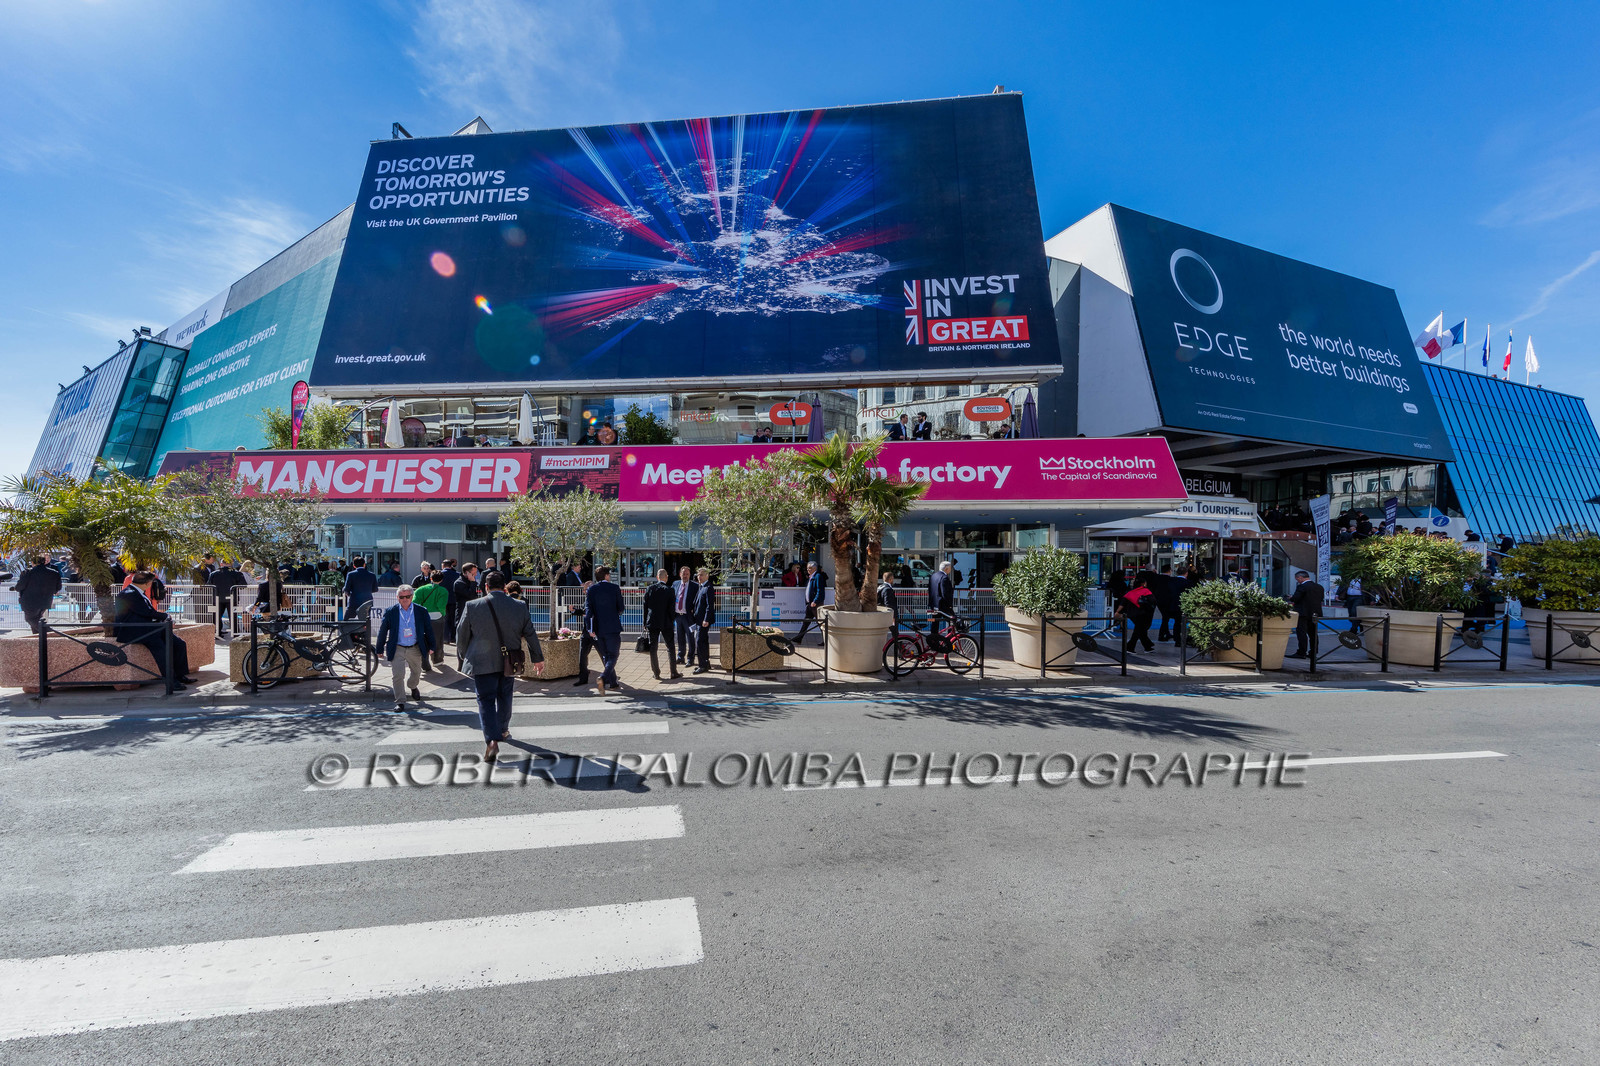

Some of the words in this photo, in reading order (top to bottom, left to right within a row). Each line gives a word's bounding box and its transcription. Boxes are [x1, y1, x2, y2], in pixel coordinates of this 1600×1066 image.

[377, 154, 475, 175] DISCOVER
[374, 170, 506, 192] TOMORROW'S
[369, 186, 530, 211] OPPORTUNITIES
[366, 219, 388, 228] Visit
[389, 218, 404, 227] the
[406, 217, 421, 226] UK
[423, 215, 479, 226] Government
[481, 213, 518, 223] Pavilion
[924, 274, 1020, 298] INVEST
[925, 298, 951, 318] IN
[931, 318, 1024, 341] GREAT
[185, 355, 213, 378] GLOBALLY
[211, 341, 248, 366] CONNECTED
[247, 324, 278, 349] EXPERTS
[1000, 342, 1031, 350] IRELAND
[1173, 322, 1253, 361] EDGE
[1278, 323, 1308, 346] the
[1310, 333, 1355, 358] world
[1358, 345, 1402, 368] needs
[334, 351, 427, 365] invest.great.gov.uk
[179, 376, 205, 396] SHARING
[204, 371, 218, 385] ONE
[217, 355, 251, 378] OBJECTIVE
[1189, 366, 1256, 385] TECHNOLOGIES
[1286, 349, 1338, 377] better
[1340, 360, 1410, 394] buildings
[170, 400, 206, 423] EXCEPTIONAL
[205, 386, 240, 410] OUTCOMES
[239, 381, 255, 398] FOR
[254, 371, 279, 390] EVERY
[279, 358, 310, 381] CLIENT
[545, 457, 605, 467] #mcrMIPIM
[1067, 456, 1156, 470] Stockholm
[236, 458, 521, 493] MANCHESTER
[641, 463, 712, 486] Meet
[898, 458, 1013, 489] factory
[1041, 472, 1058, 481] The
[1059, 472, 1091, 482] Capital
[1092, 471, 1101, 480] of
[1103, 471, 1157, 480] Scandinavia
[1185, 478, 1231, 493] BELGIUM
